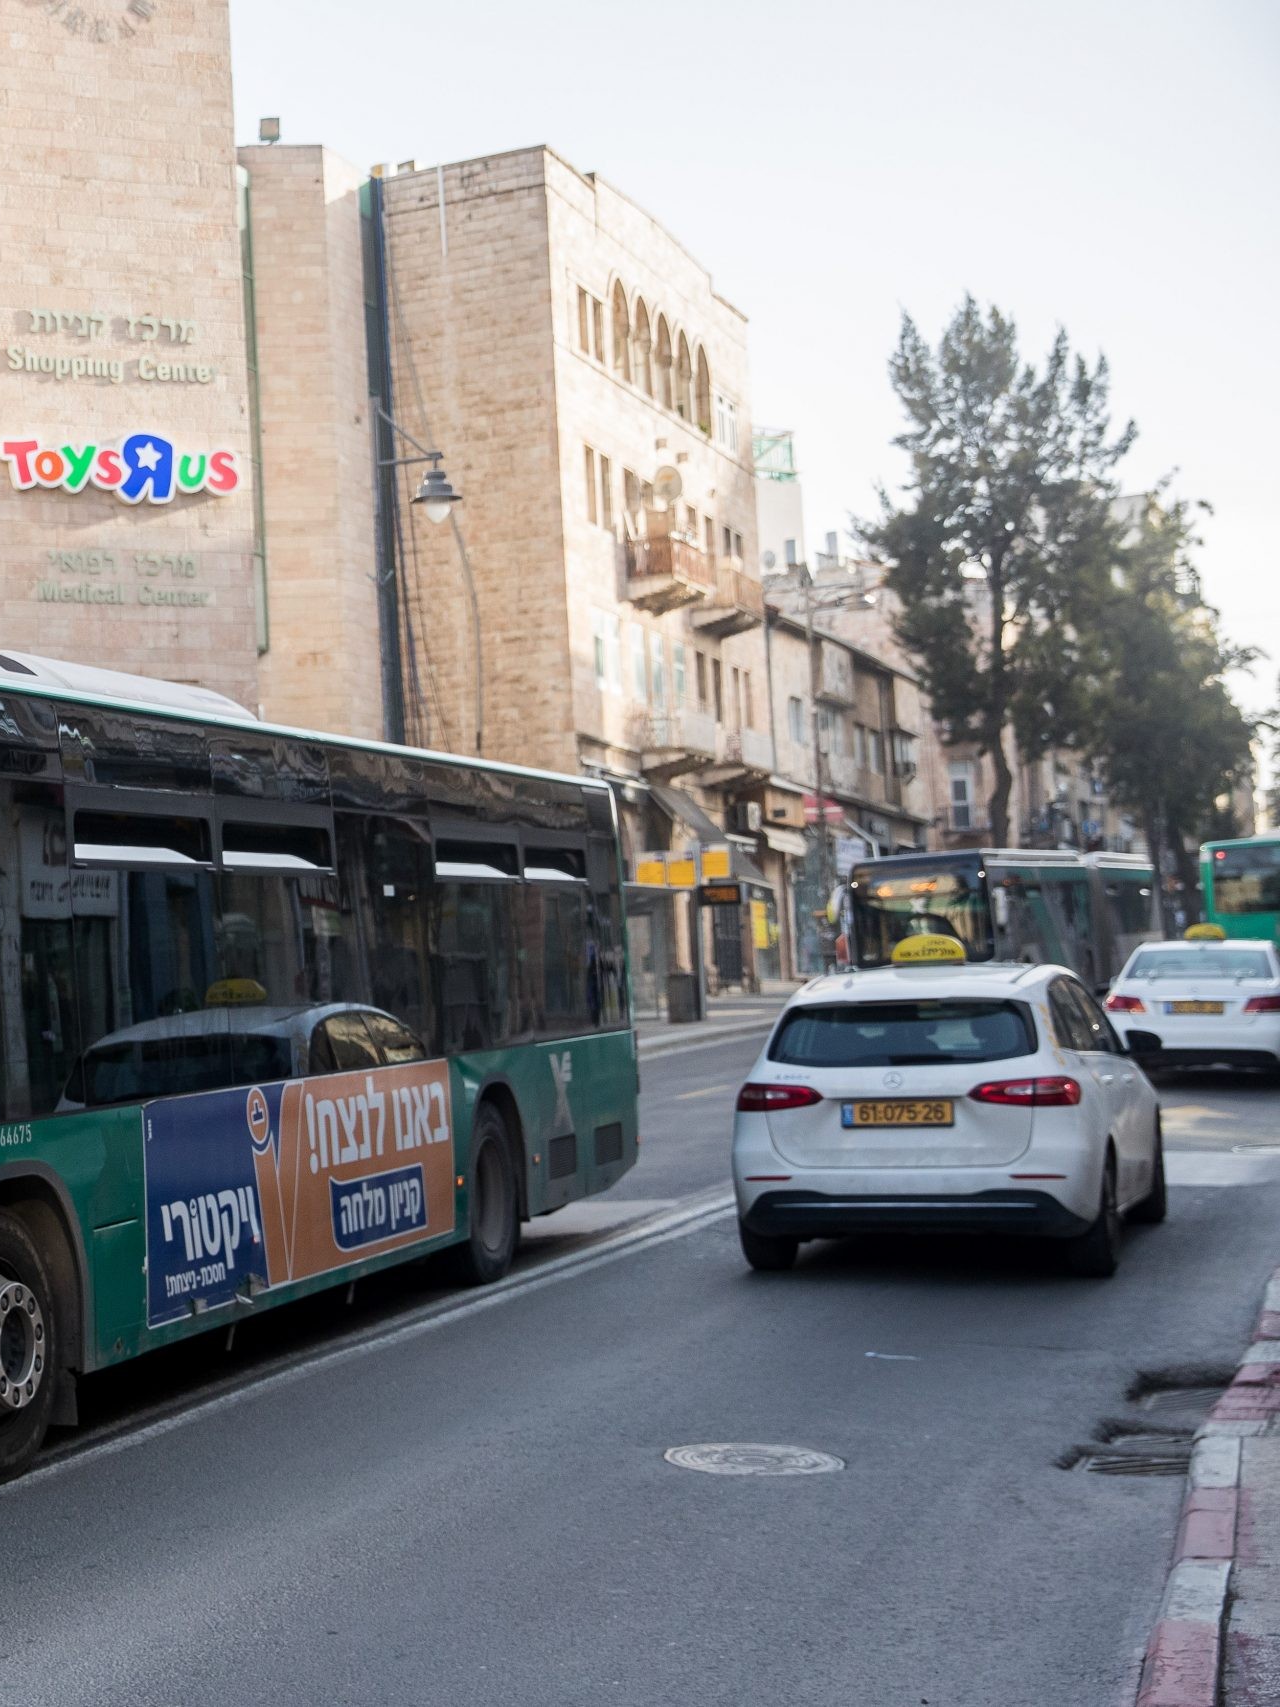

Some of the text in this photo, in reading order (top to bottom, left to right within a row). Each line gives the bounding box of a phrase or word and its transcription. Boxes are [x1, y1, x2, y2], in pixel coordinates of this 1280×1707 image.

[30, 308, 199, 344] מרכז קניות
[7, 347, 124, 384] Shopping
[134, 551, 198, 578] מרכז
[36, 579, 211, 607] Medical Center
[0, 1124, 32, 1147] 64675
[304, 1075, 450, 1176] באנו לנצח!
[339, 1178, 421, 1236] קניון מלחה
[160, 1185, 261, 1271] ויקטורי
